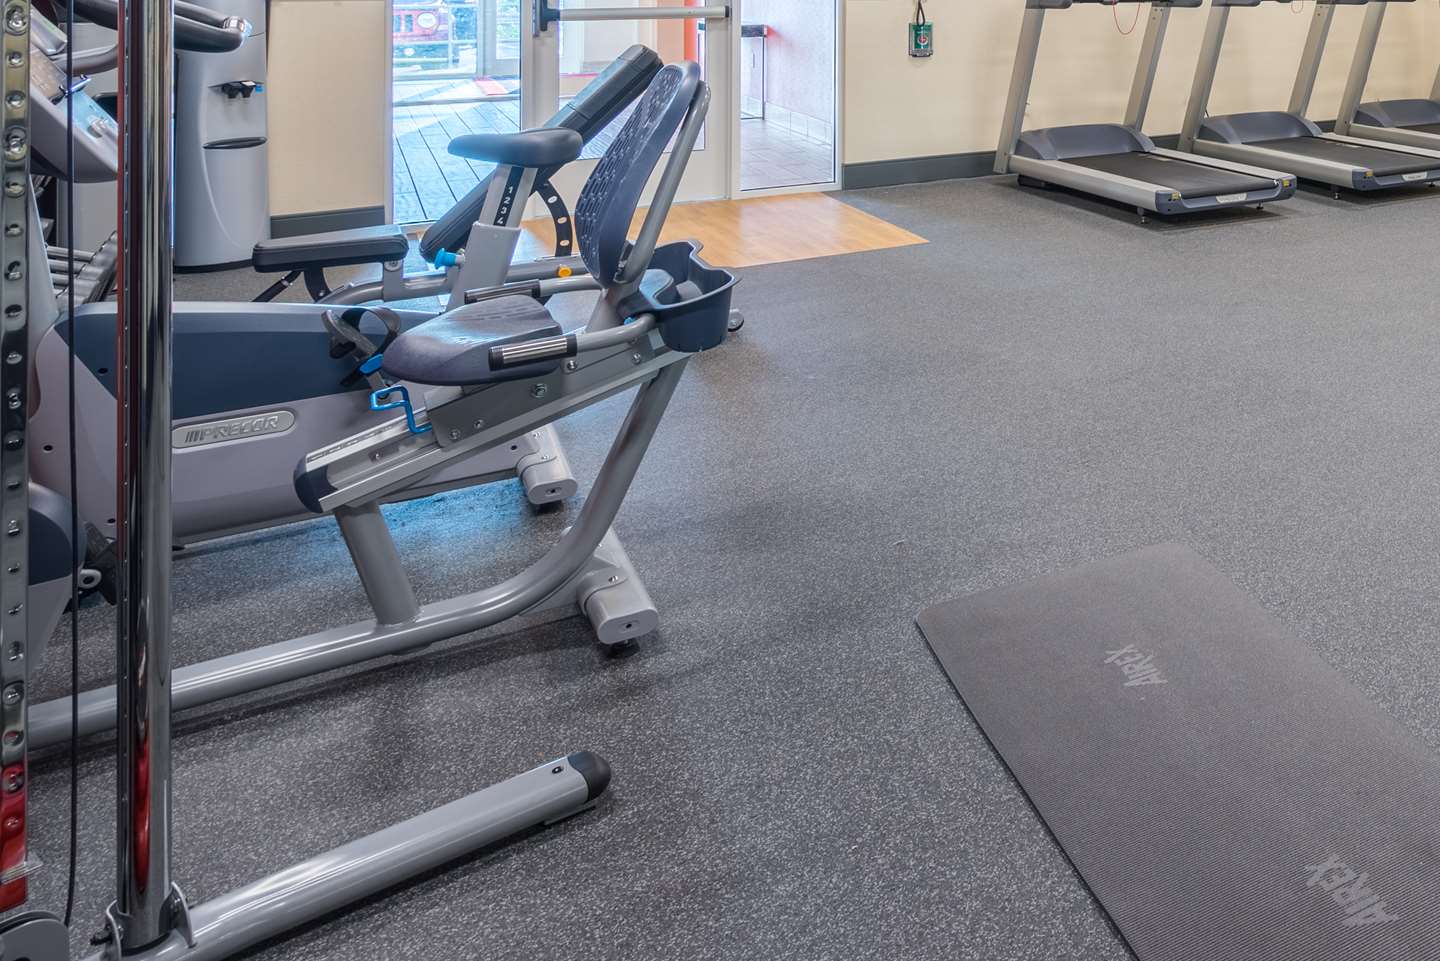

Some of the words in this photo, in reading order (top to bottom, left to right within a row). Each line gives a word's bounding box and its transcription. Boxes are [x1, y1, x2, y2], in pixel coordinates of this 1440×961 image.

[195, 415, 279, 441] PRECOR
[1104, 644, 1168, 688] AIREX
[1305, 854, 1399, 928] AIREX
